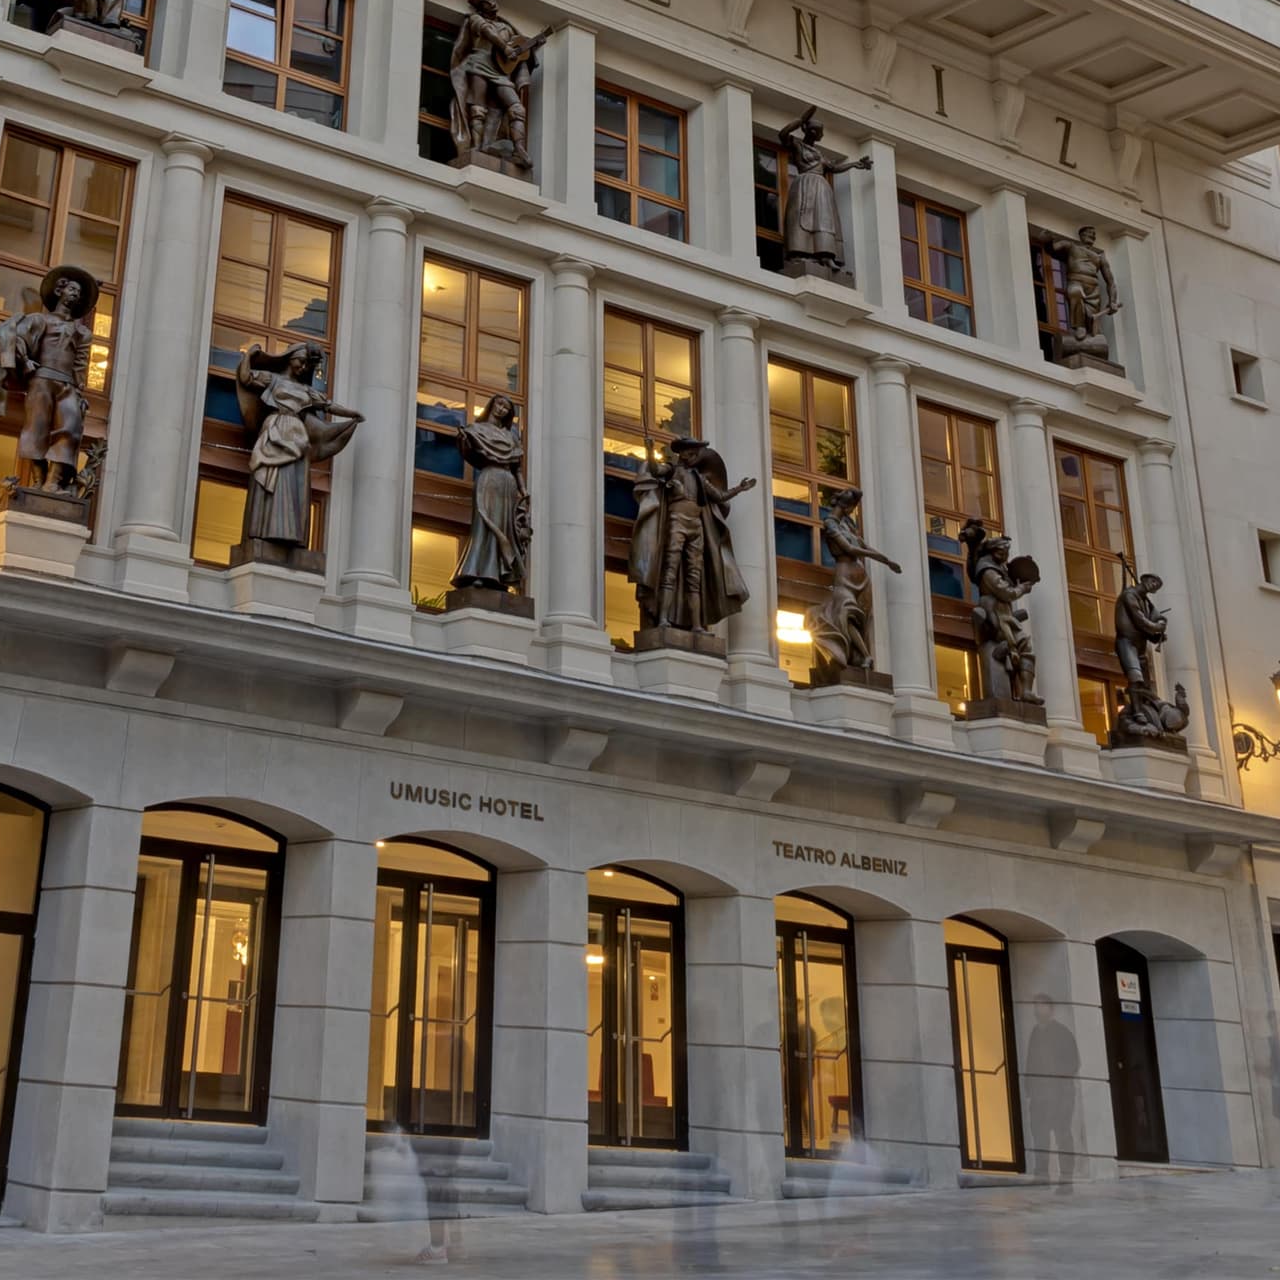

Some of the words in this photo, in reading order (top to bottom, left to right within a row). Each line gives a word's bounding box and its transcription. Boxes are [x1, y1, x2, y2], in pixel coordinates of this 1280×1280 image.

[390, 781, 471, 812] UMUSIC
[479, 795, 545, 822] HOTEL
[772, 840, 836, 865] TEATRO
[840, 852, 908, 877] ALBENIZ
